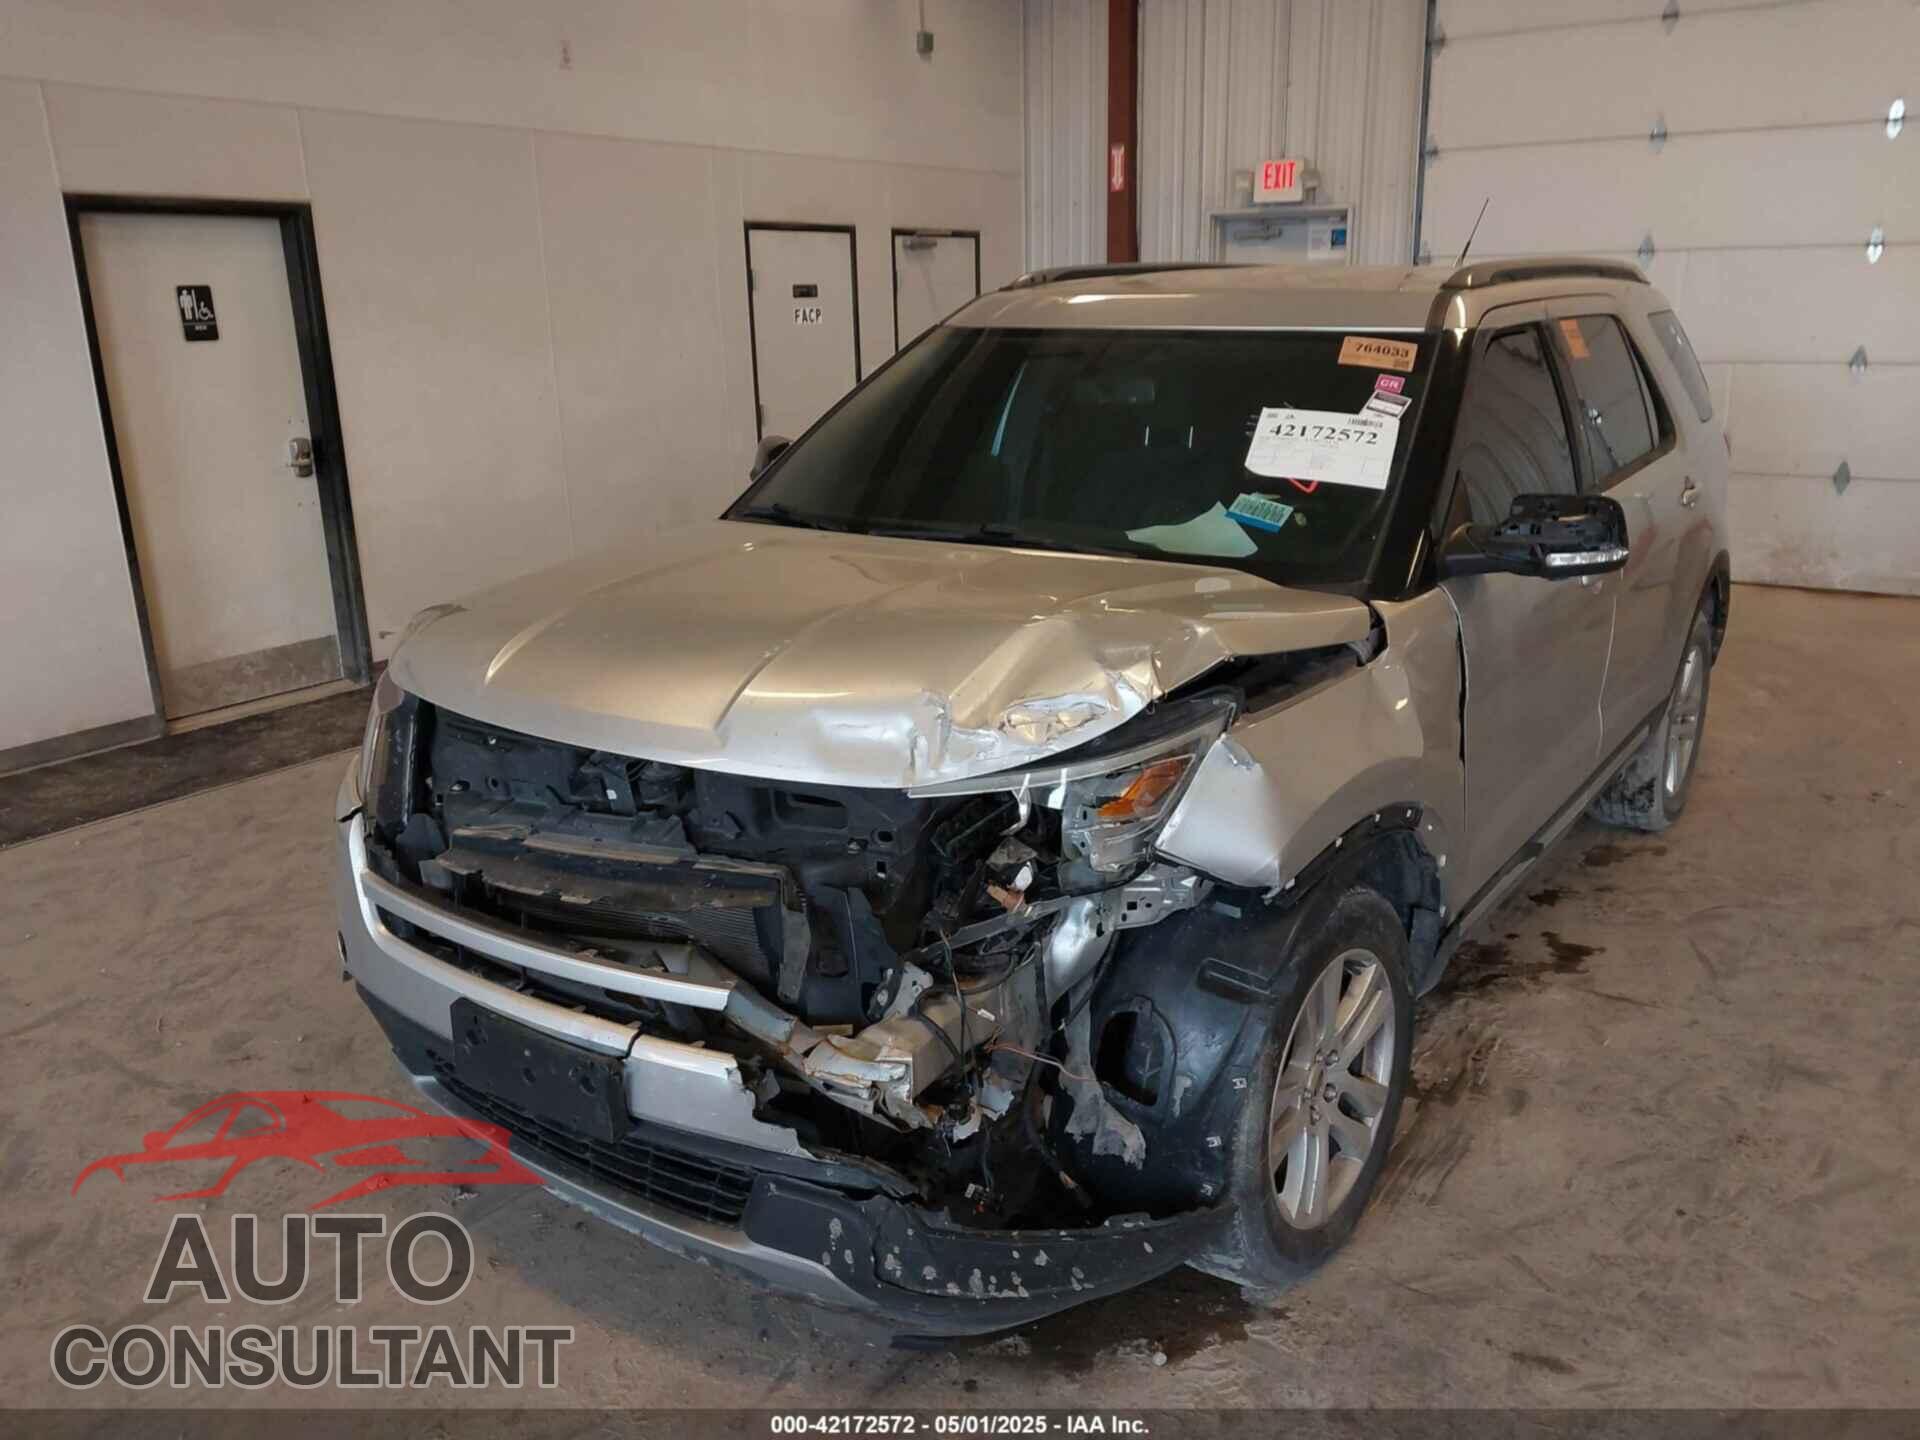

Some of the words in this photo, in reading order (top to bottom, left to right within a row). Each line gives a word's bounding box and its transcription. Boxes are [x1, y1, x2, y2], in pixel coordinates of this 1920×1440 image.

[1264, 161, 1296, 190] EXIT
[794, 308, 822, 323] FACP
[1354, 342, 1410, 359] 764033
[1269, 423, 1379, 445] 42172572
